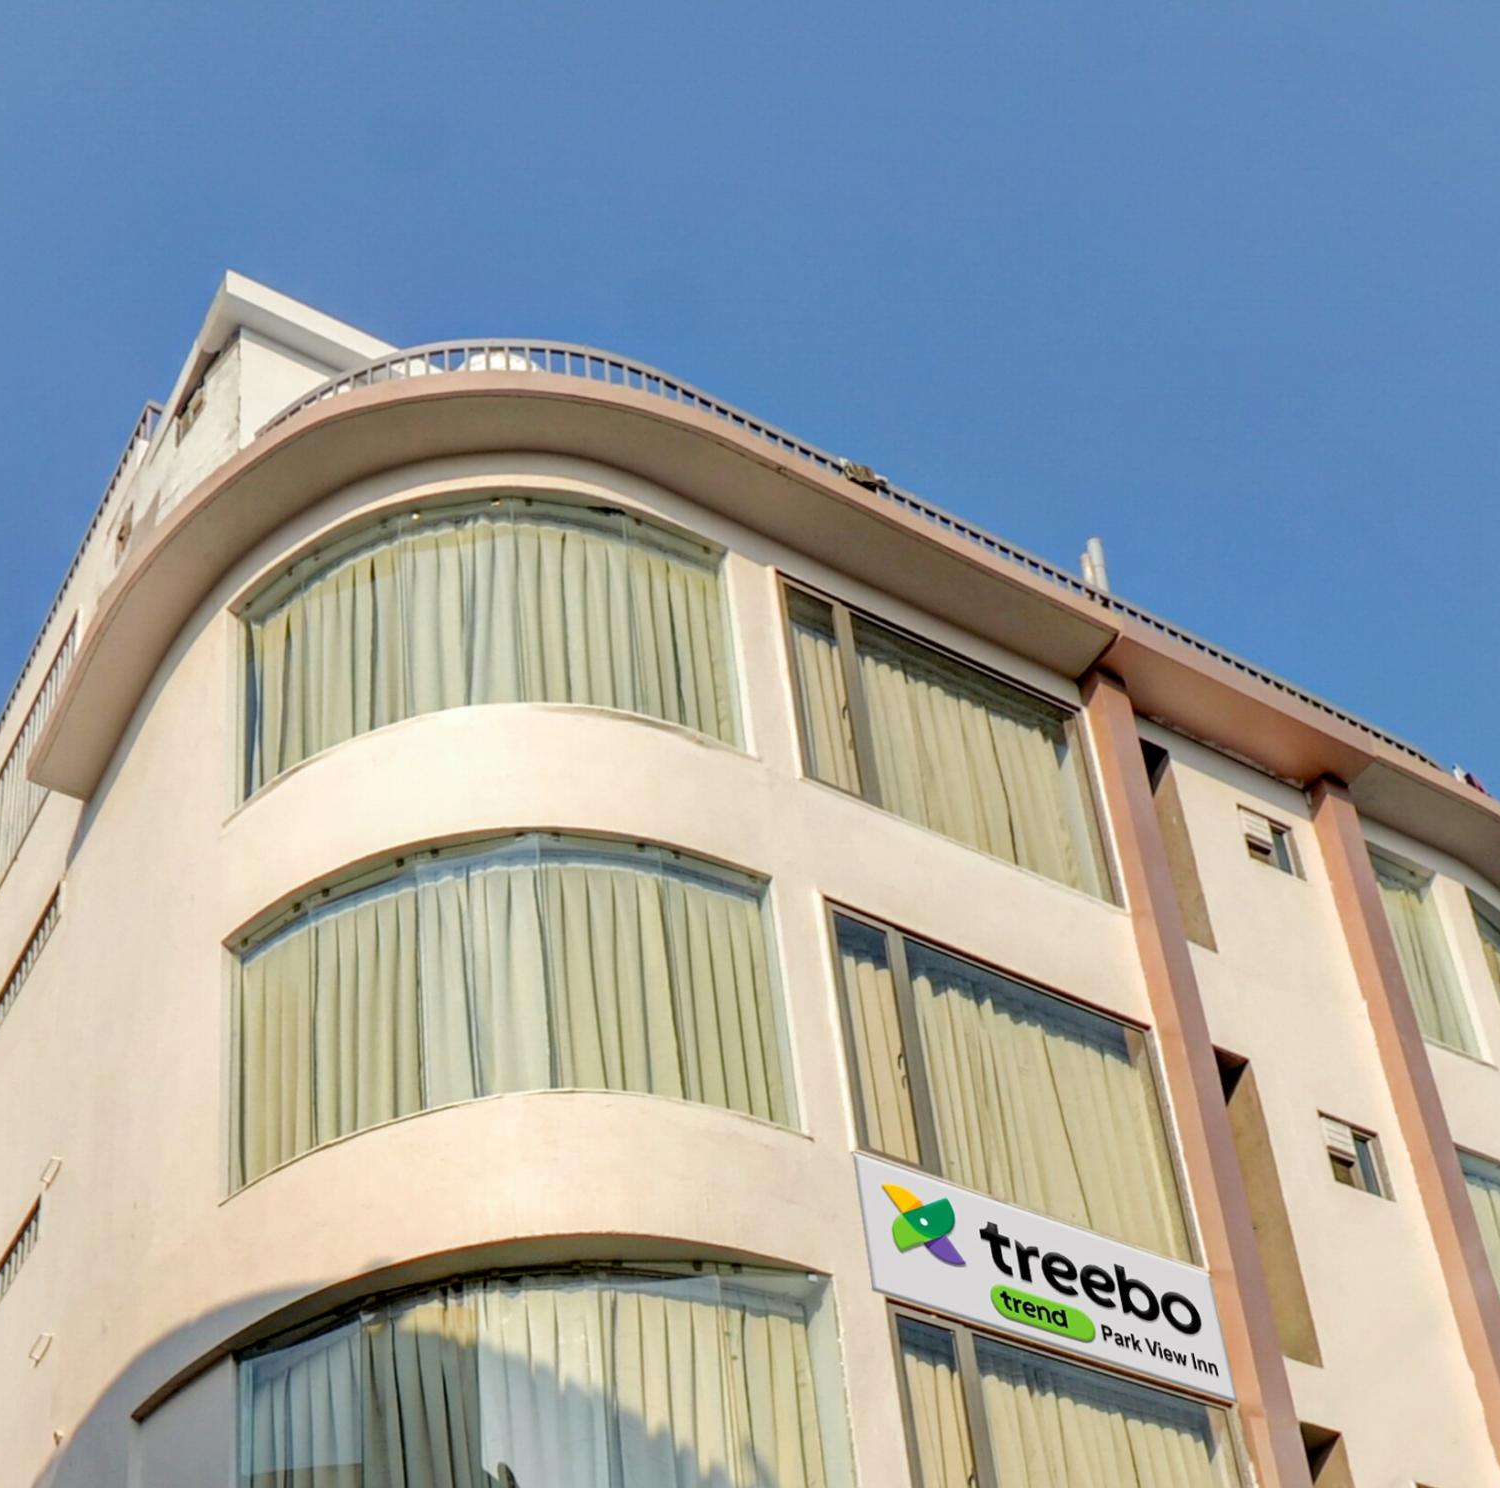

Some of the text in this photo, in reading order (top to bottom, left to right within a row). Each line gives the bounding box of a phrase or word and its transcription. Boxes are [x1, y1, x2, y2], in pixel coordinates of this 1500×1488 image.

[979, 1221, 1202, 1335] treebo
[999, 1289, 1068, 1330] trend
[1101, 1323, 1220, 1378] Park View Inn
